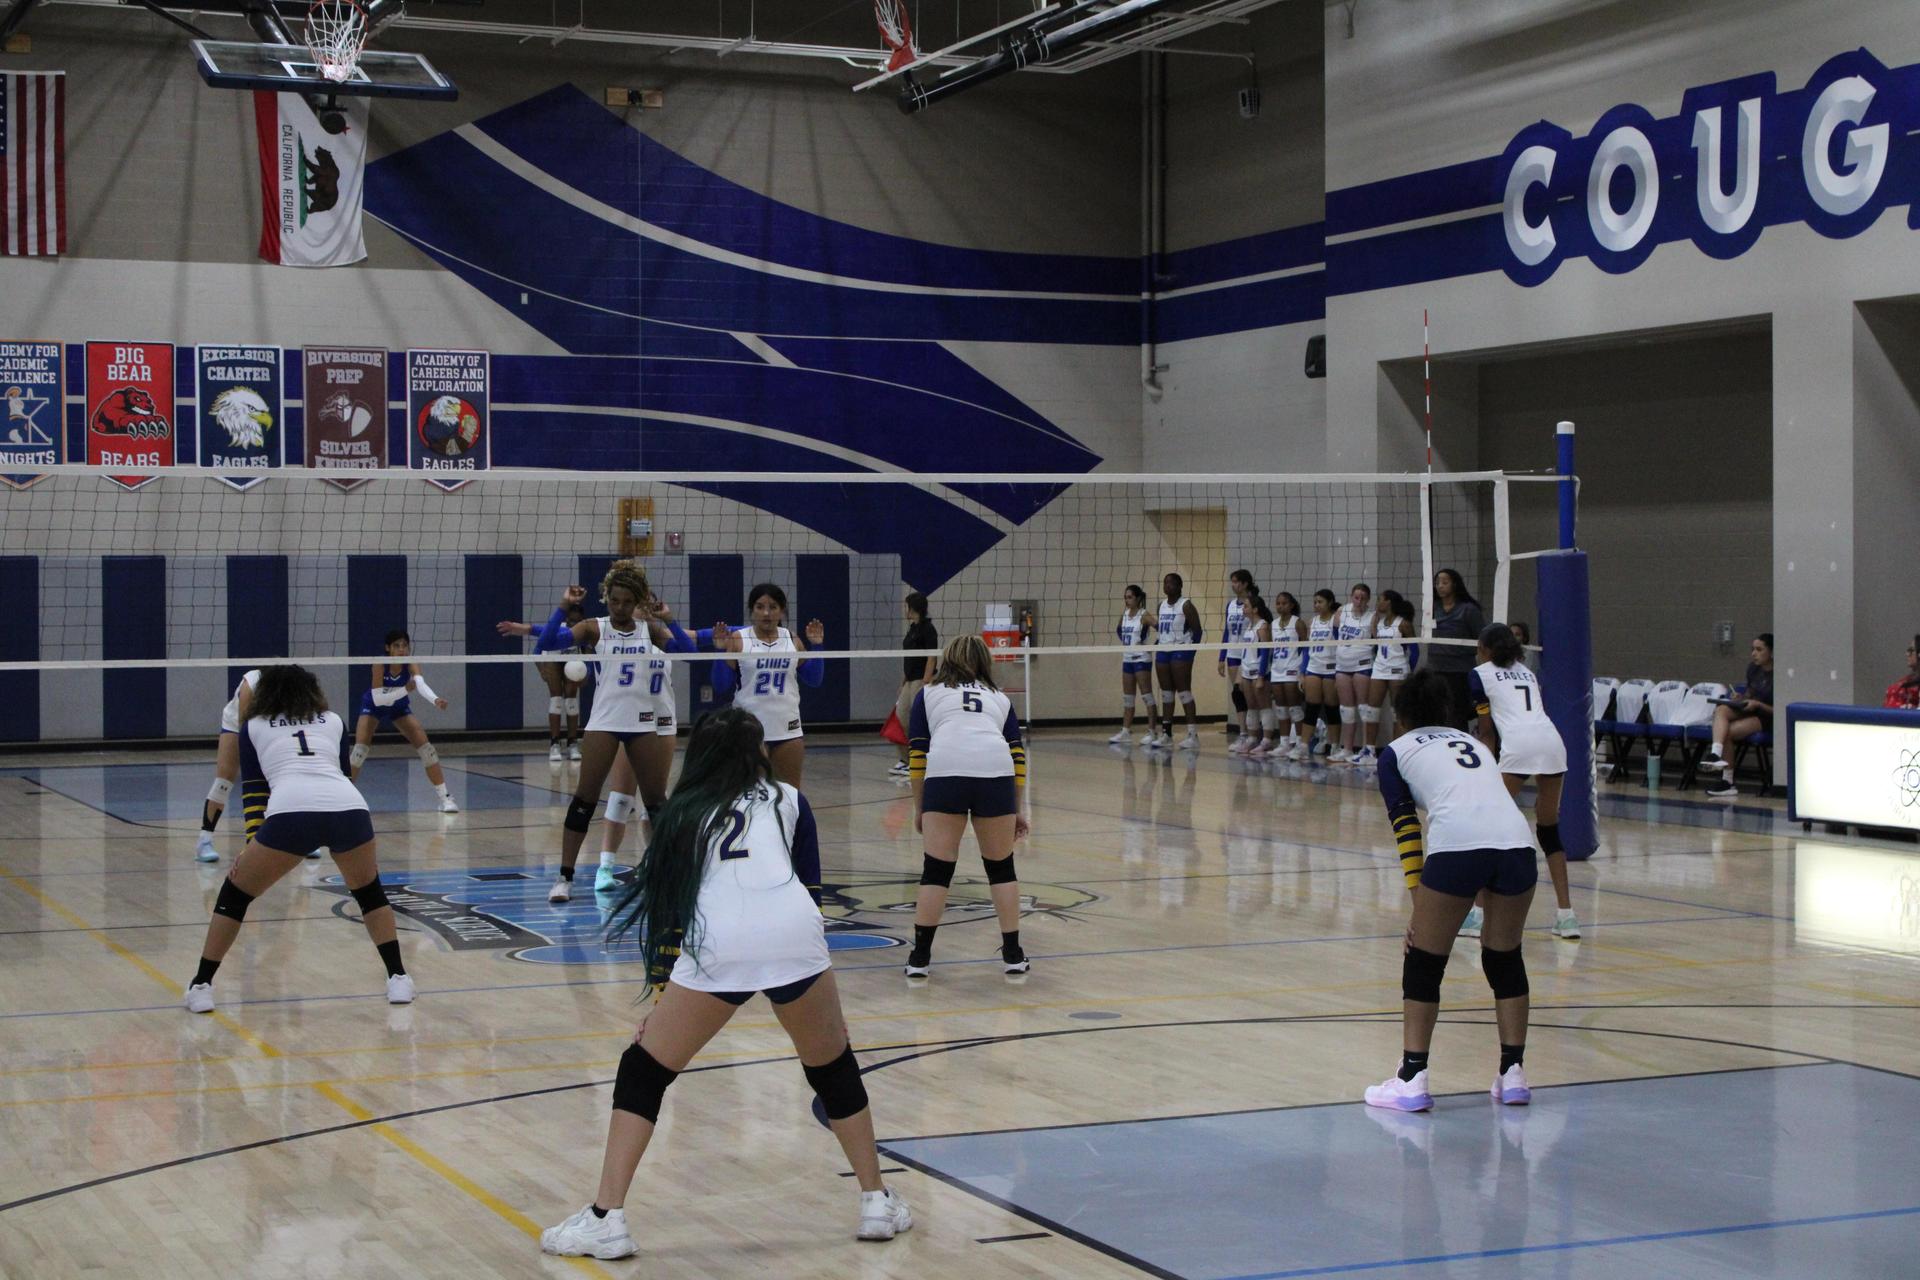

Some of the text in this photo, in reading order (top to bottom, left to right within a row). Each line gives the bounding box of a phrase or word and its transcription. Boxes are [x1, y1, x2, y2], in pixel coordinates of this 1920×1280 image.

[281, 124, 294, 234] CALIFORNIA REPUBLIC
[36, 345, 59, 357] FOR
[115, 347, 145, 365] BIG
[202, 349, 276, 364] EXCELSIOR
[307, 351, 383, 367] RIVERSIDE
[415, 354, 481, 367] ACADEMY OF
[107, 364, 152, 382] BEAR
[207, 366, 271, 382] CHARTER
[326, 368, 364, 384] PREP
[411, 367, 485, 380] CAREERS AND
[411, 379, 484, 393] EXPLORATION
[320, 440, 371, 455] SILVER
[100, 450, 160, 467] BEARS
[212, 454, 269, 468] EAGLES
[422, 456, 475, 470] EAGLES
[617, 661, 637, 688] 5
[649, 670, 666, 696] 0
[754, 670, 788, 697] 24
[962, 690, 983, 713] 5
[1514, 685, 1532, 712] 7
[290, 729, 316, 756] 1
[1447, 740, 1482, 769] 3
[719, 808, 749, 861] 2
